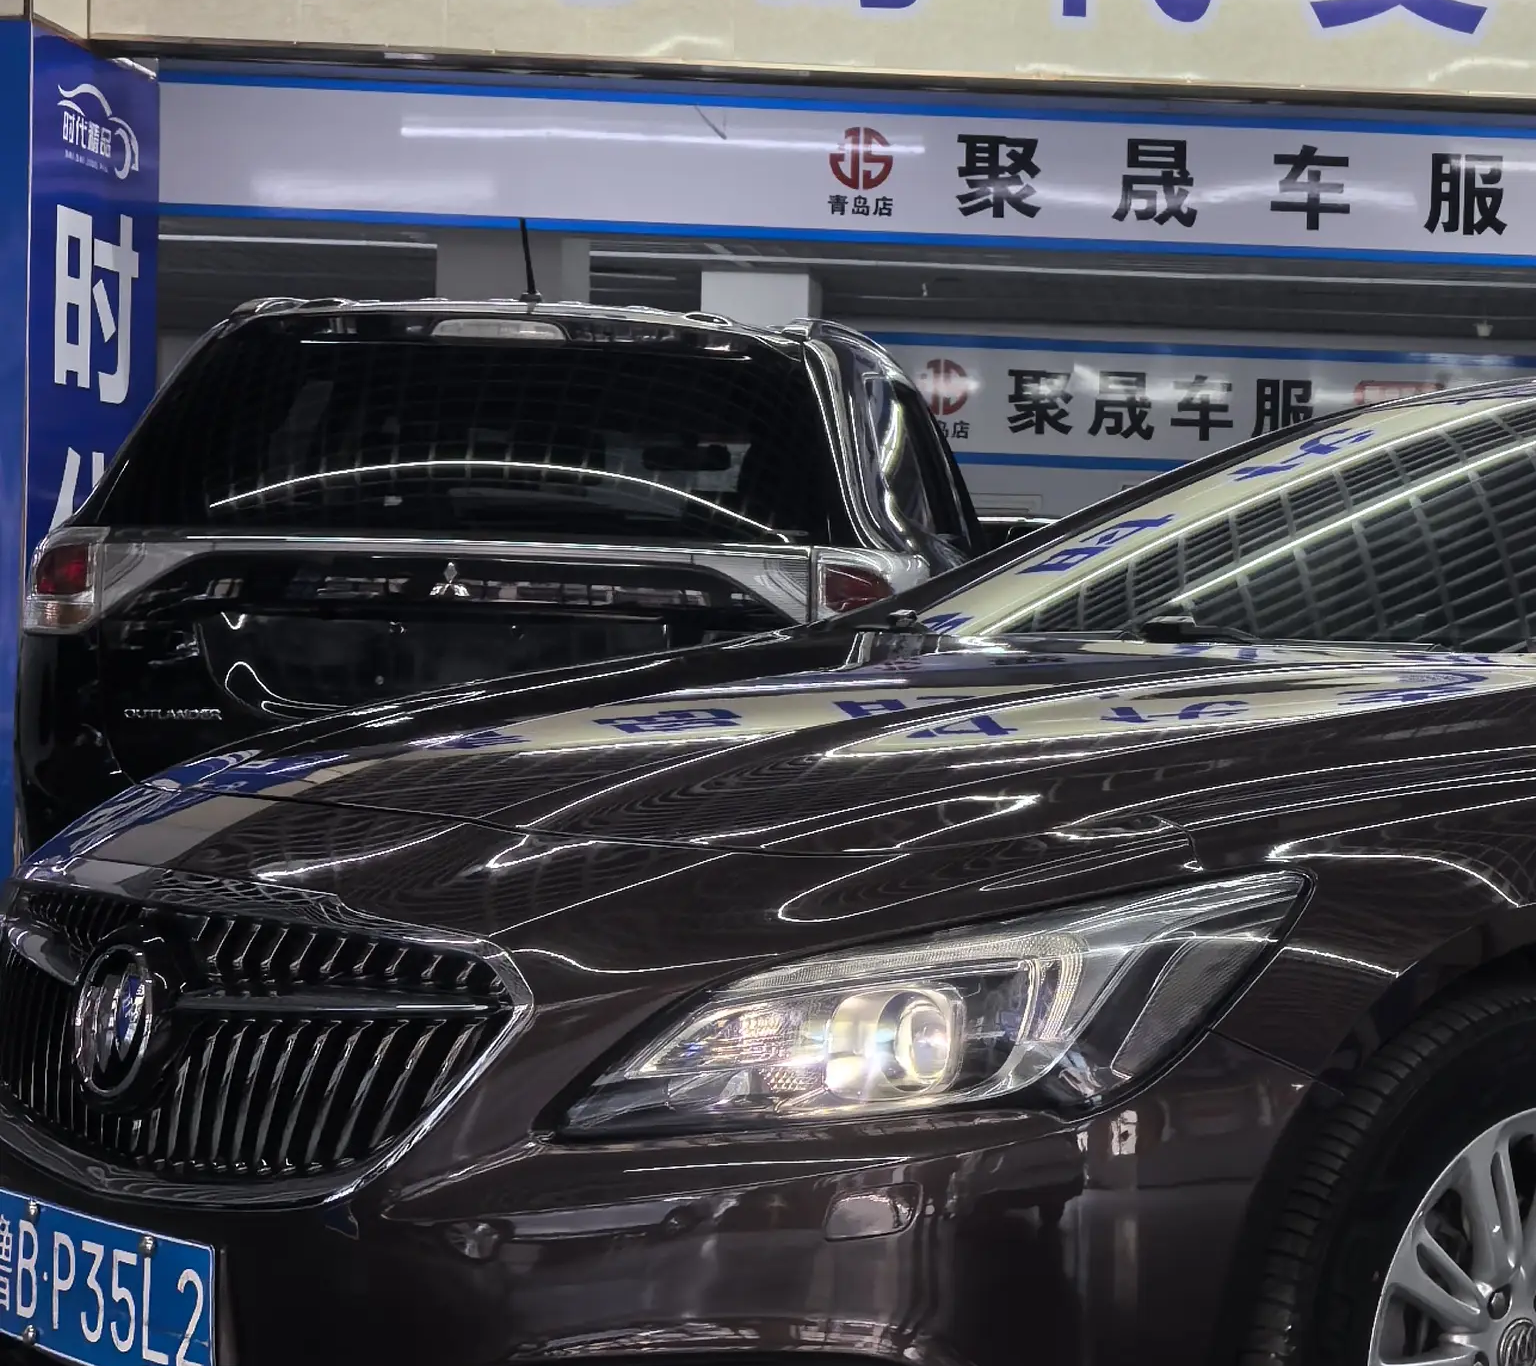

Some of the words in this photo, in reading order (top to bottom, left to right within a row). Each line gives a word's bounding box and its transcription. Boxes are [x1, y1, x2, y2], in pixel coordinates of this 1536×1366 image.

[828, 194, 893, 217] 青岛店
[956, 134, 1508, 237] 聚晟车服
[1006, 369, 1315, 441] 聚晟车服
[124, 708, 222, 721] OUTLANDER
